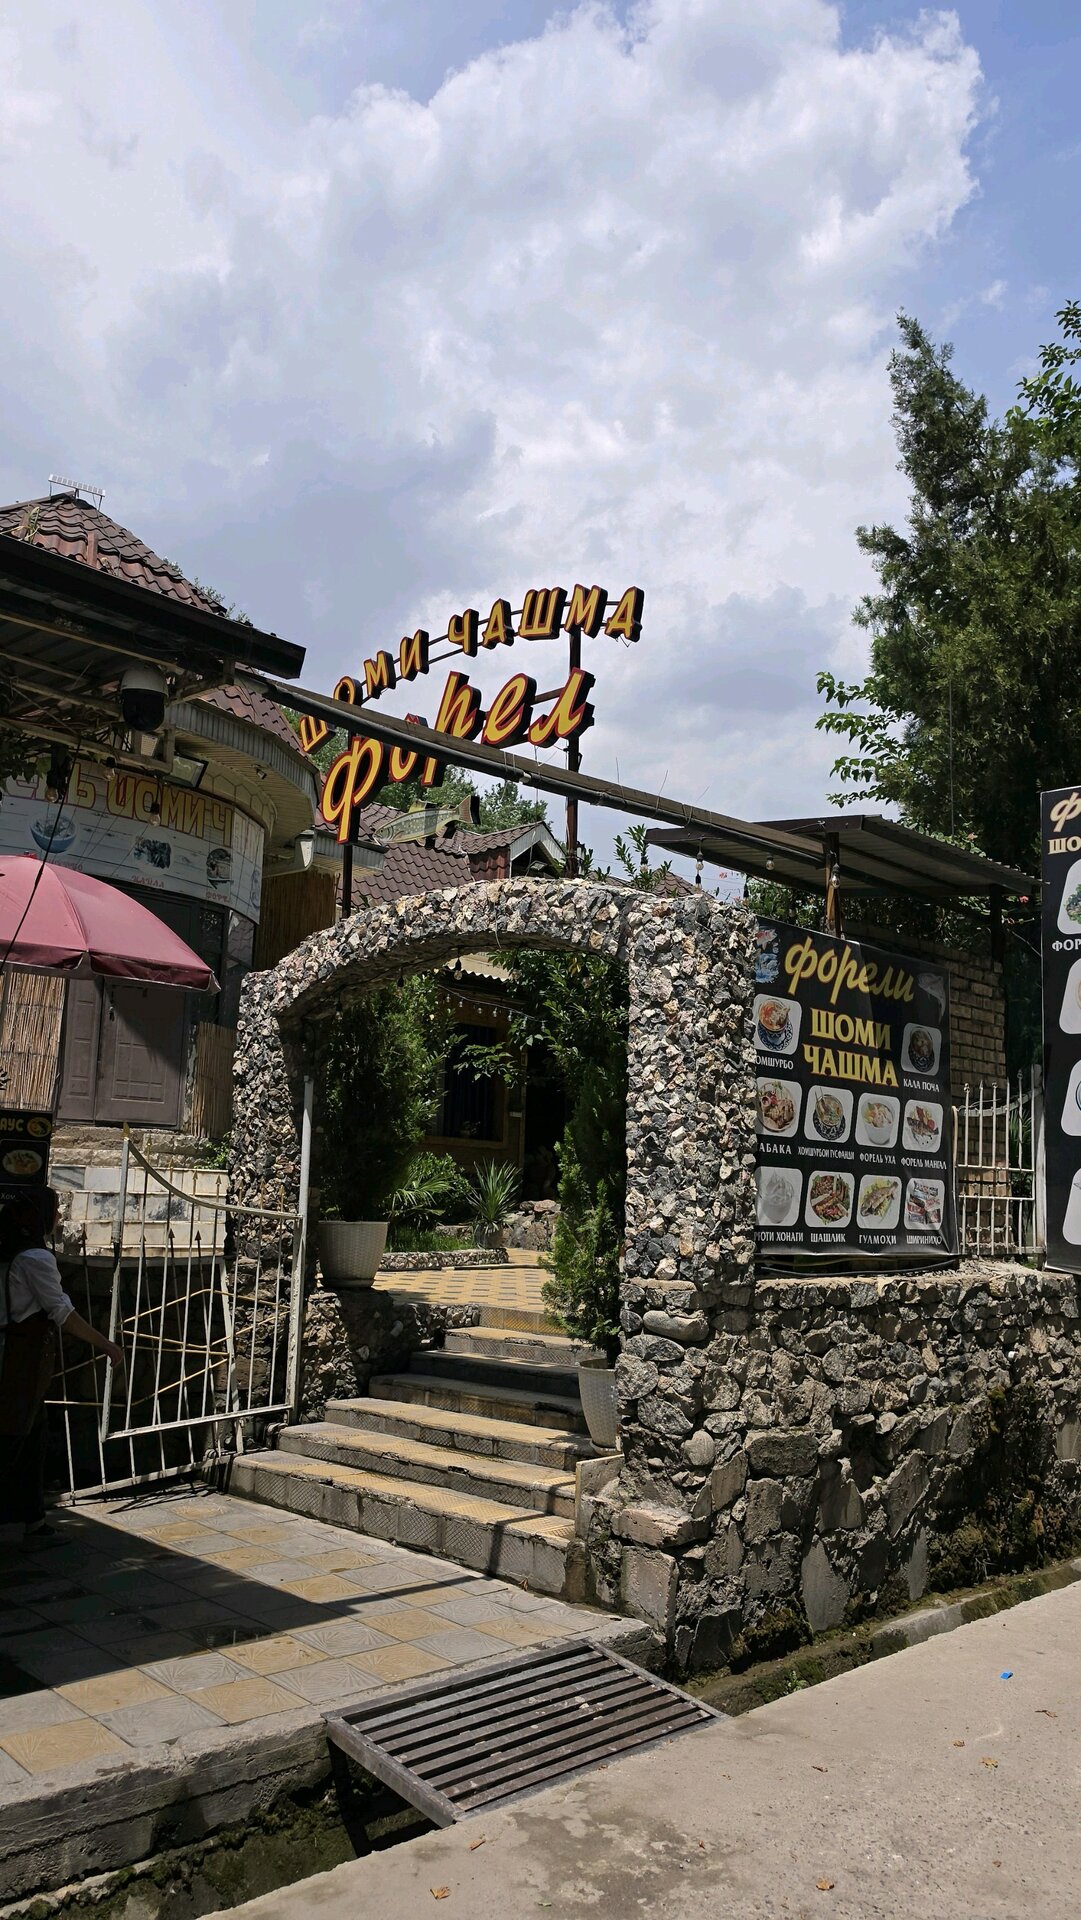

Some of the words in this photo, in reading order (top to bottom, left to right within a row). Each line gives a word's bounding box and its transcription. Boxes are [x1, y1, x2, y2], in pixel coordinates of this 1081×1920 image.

[300, 629, 429, 751] ШОМИ
[448, 583, 645, 658] ЧАШМА
[1047, 836, 1081, 855] ШО
[1052, 938, 1081, 952] ФОР
[810, 1007, 892, 1050] ШОМИ
[755, 1055, 794, 1070] ОМШУРБО
[802, 1043, 900, 1088] ЧАШМА
[758, 1142, 792, 1155] АБАКА
[859, 1149, 883, 1163] ФОРЕЛЬ
[884, 1153, 896, 1165] УХА
[900, 1157, 924, 1168] ФОРЕЛЬ
[776, 1231, 804, 1242] ХОНАГИ
[810, 1232, 846, 1243] ШАШЛИК
